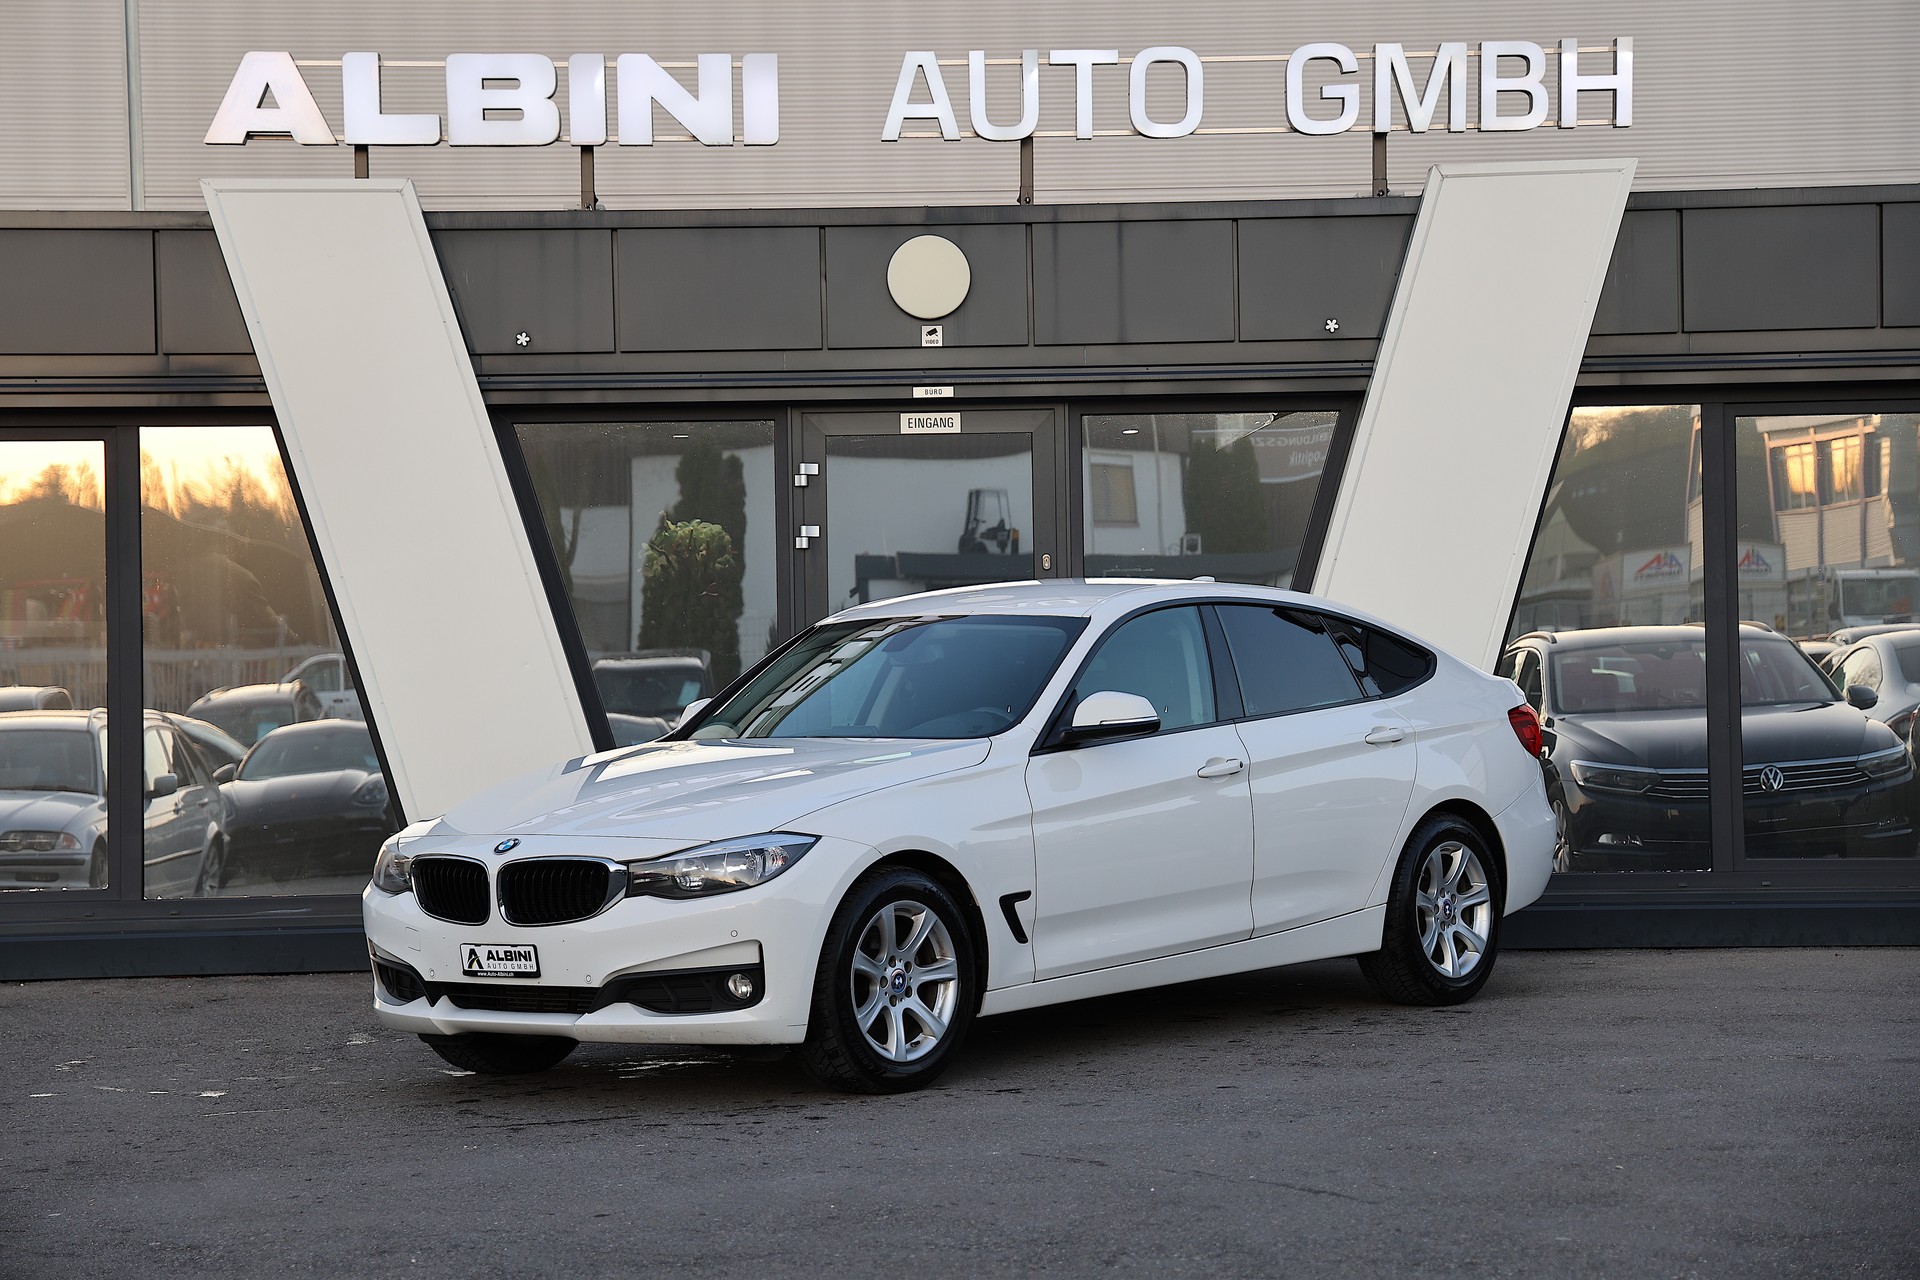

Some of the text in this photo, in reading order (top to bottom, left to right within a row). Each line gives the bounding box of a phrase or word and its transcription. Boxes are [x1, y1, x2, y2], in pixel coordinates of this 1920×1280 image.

[204, 36, 1634, 146] ALBINI AUTO GMBH
[908, 417, 954, 428] EINGANG
[486, 950, 532, 961] ALBINI
[487, 962, 508, 970] AUTO
